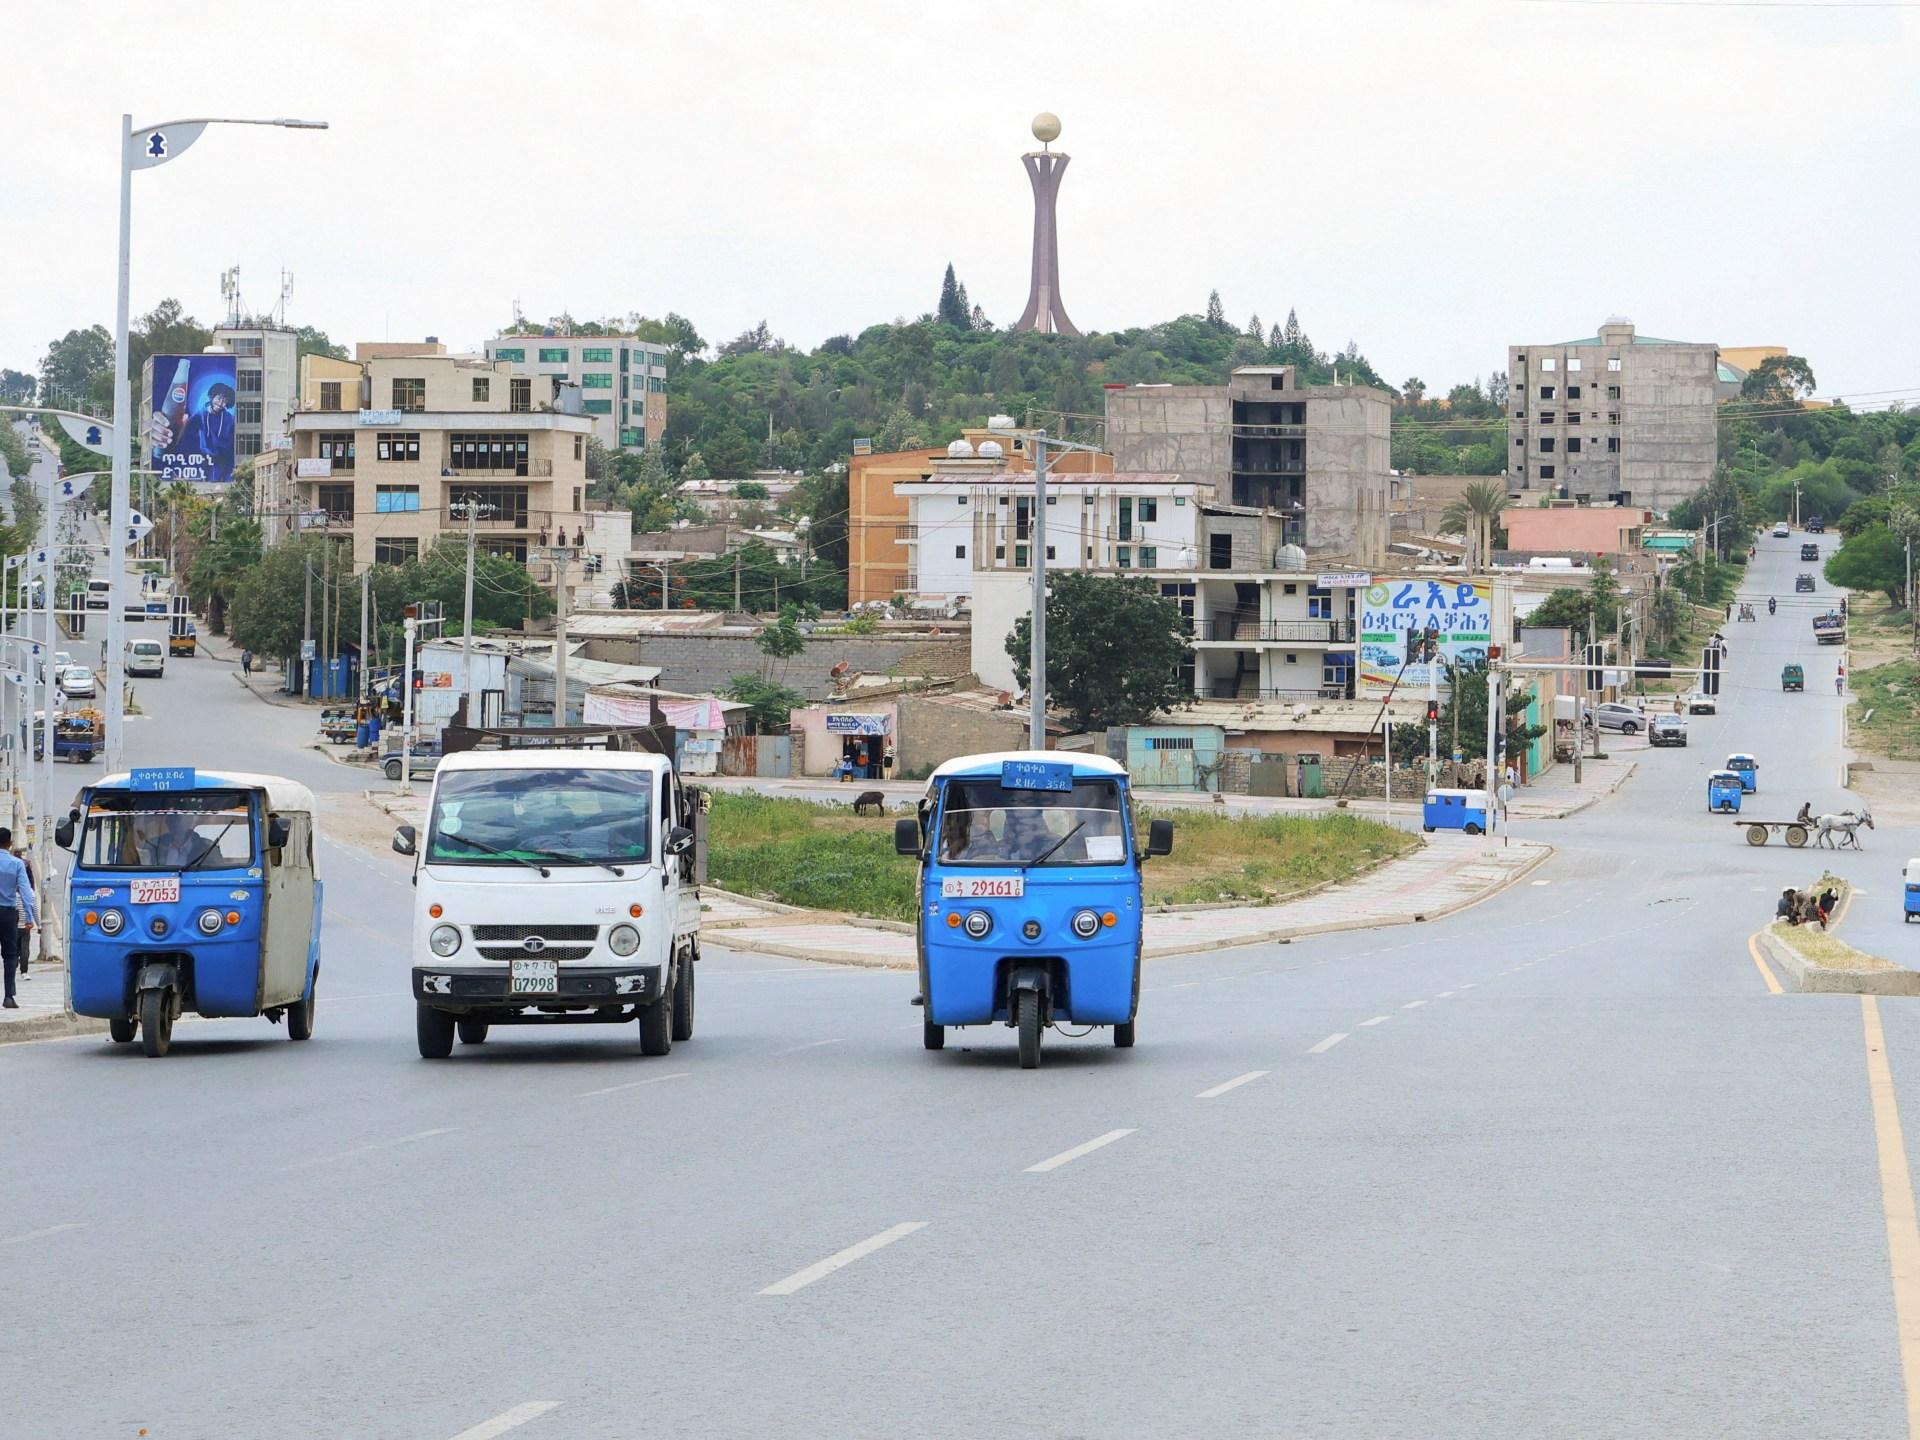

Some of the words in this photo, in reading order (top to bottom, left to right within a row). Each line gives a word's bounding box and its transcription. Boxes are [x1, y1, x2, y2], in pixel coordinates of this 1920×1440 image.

[1392, 581, 1480, 610] ራእይ
[153, 781, 170, 790] 101
[971, 880, 1012, 895] 29161
[138, 888, 177, 902] 27053
[514, 977, 554, 991] 07998
